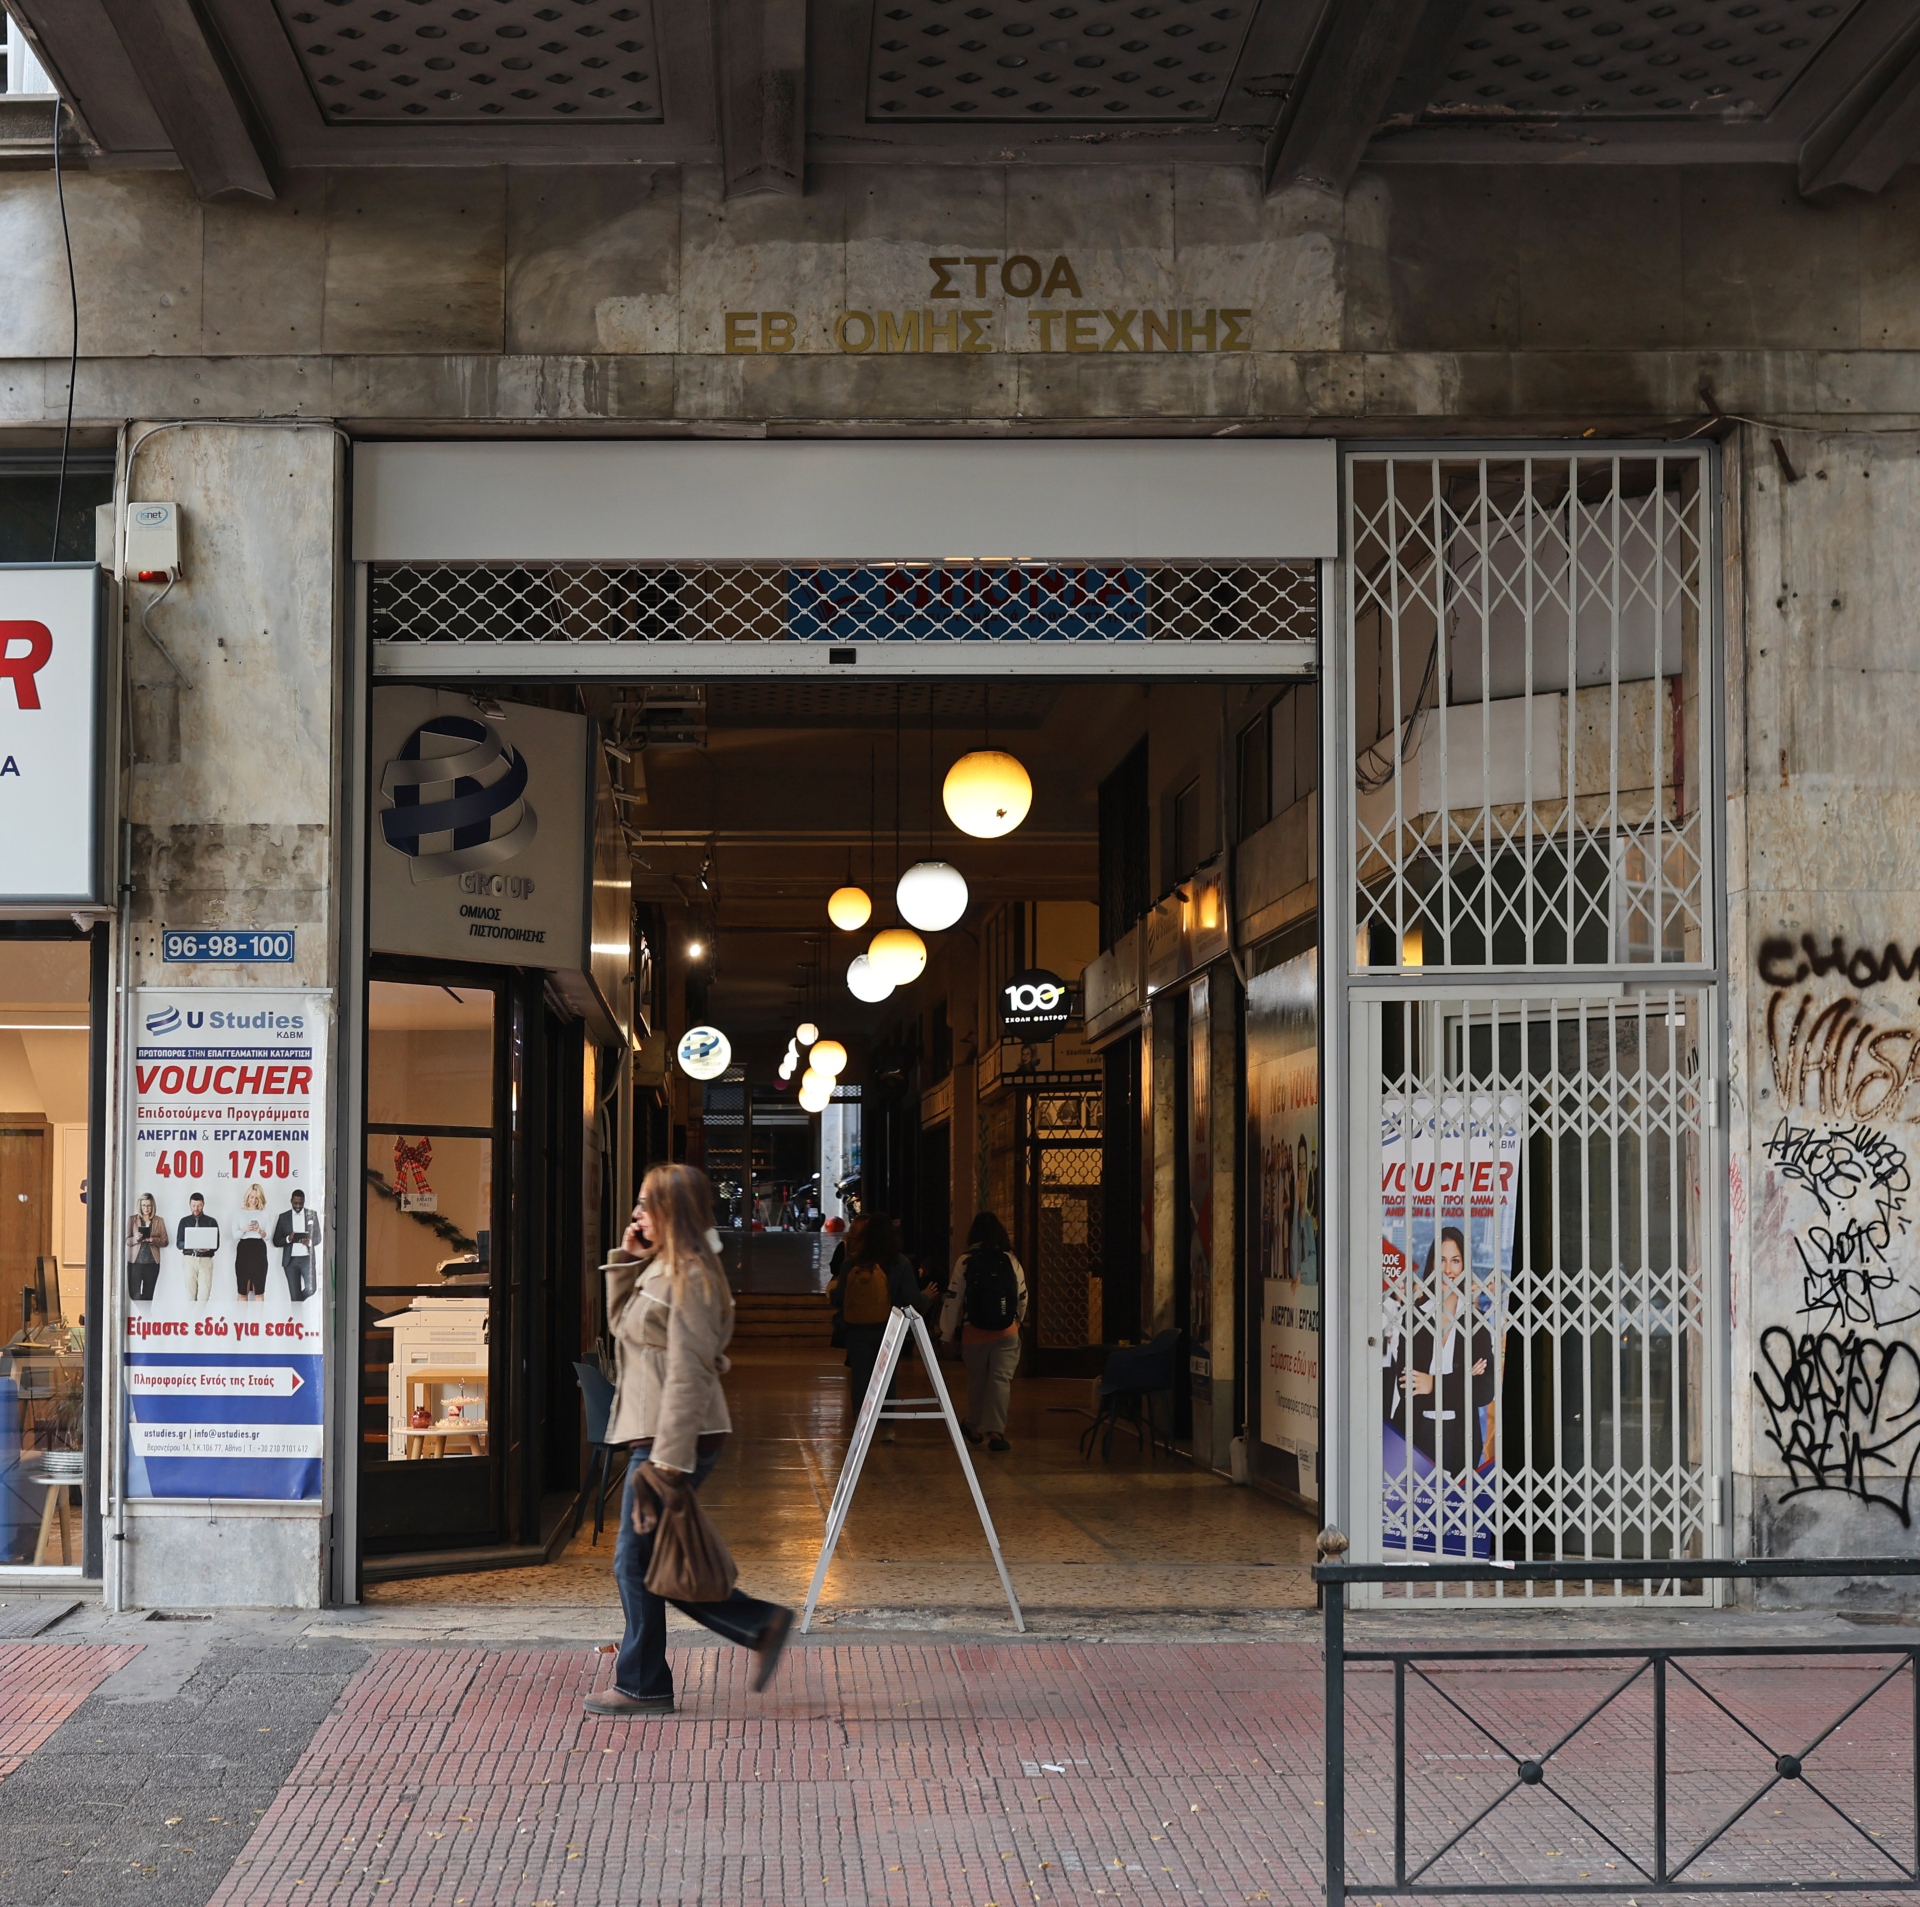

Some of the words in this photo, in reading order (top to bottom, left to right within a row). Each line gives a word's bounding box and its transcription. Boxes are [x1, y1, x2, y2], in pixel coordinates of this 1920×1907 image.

[929, 255, 1082, 298] ΣΤΟΑ
[1028, 309, 1252, 352] ΤΕΧΝΗΣ
[459, 871, 535, 899] GROUP
[459, 904, 502, 920] ΟΜΙΛΟΣ
[469, 924, 547, 943] ΠΙΣΤΟΠΟΙΗΣΗΣ
[168, 936, 289, 957] 96-98-100
[187, 1012, 203, 1028] U
[209, 1011, 304, 1029] Studies
[1033, 1014, 1068, 1023] ΘΕΑΤΡΟΥ
[136, 1066, 313, 1095] VOUCHER
[137, 1106, 222, 1121] Επιδοτούμενα
[227, 1106, 309, 1121] Προγράμματα
[137, 1130, 197, 1141] ΑΝΕΡΓΩΝ
[202, 1130, 209, 1141] &
[214, 1130, 309, 1141] ΕΡΓΑΖΟΜΕΝΩΝ
[1488, 1140, 1516, 1149] ΚΒΜ
[145, 1150, 156, 1158] από
[156, 1150, 204, 1178] 400
[217, 1171, 229, 1179] έως
[229, 1150, 290, 1178] 1750
[292, 1169, 299, 1178] €
[1381, 1162, 1514, 1192] VOUCHER
[1381, 1253, 1400, 1265] 00€
[127, 1316, 189, 1340] Είμαστε
[194, 1316, 228, 1336] εδώ
[234, 1322, 260, 1341] για
[265, 1316, 320, 1340] εσάς...
[134, 1373, 196, 1387] Πληροφορίες
[200, 1373, 227, 1387] Εντός
[230, 1376, 246, 1387] της
[248, 1373, 275, 1387] Στοάς
[144, 1429, 187, 1440] ustudies.gr
[194, 1429, 260, 1440] info@ustudies.gr
